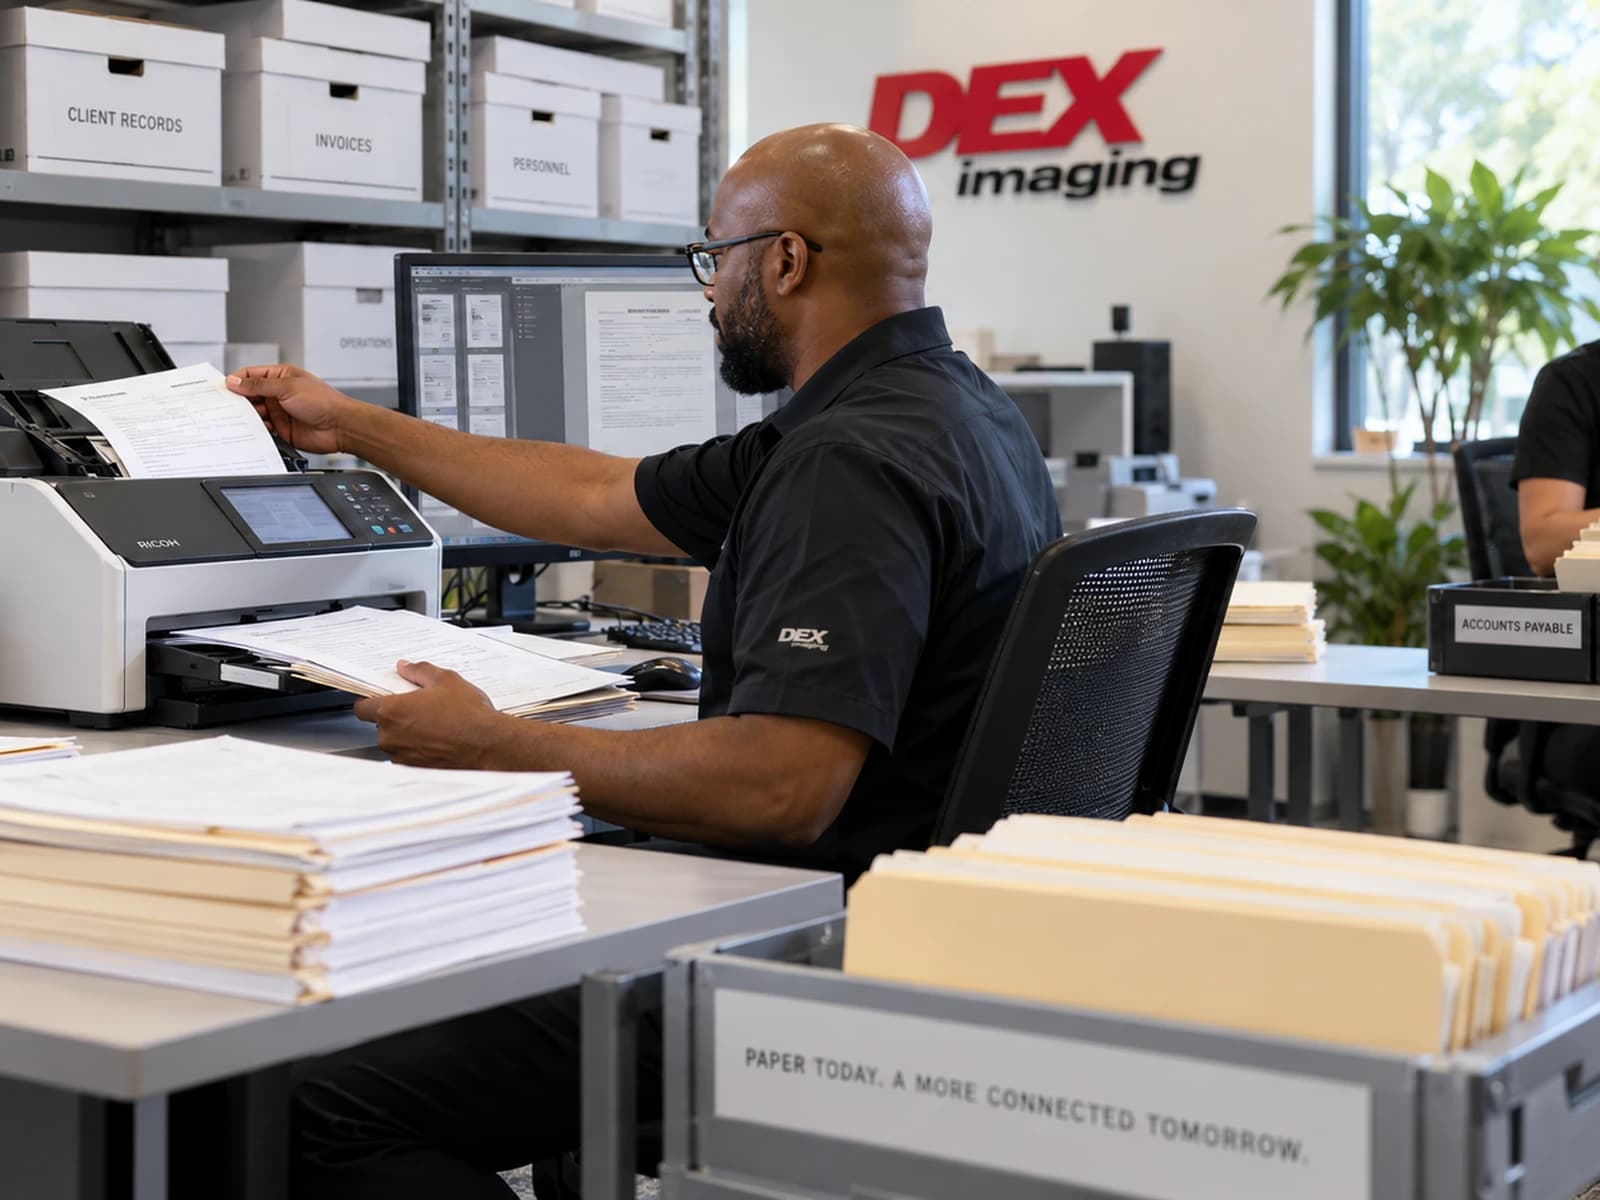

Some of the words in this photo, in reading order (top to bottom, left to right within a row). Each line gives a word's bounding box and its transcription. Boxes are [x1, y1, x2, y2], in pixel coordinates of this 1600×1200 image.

[868, 47, 1164, 160] DEX
[67, 106, 116, 126] CLIENT
[120, 112, 183, 133] RECORDS
[315, 133, 372, 152] INVOICES
[513, 156, 571, 176] PERSONNEL
[957, 149, 1201, 199] imaging
[340, 336, 393, 350] OPERATIONS
[136, 539, 181, 549] RICOH
[1462, 618, 1520, 632] ACCOUNTS
[1524, 621, 1574, 634] PAYABLE
[777, 628, 829, 644] DEX
[745, 1047, 806, 1075] PAPER
[813, 1056, 884, 1088] TODAY.
[893, 1070, 906, 1090] A
[916, 1074, 977, 1104] MORE
[986, 1085, 1135, 1132] CONNECTED
[1145, 1113, 1309, 1166] TOMORROW.
